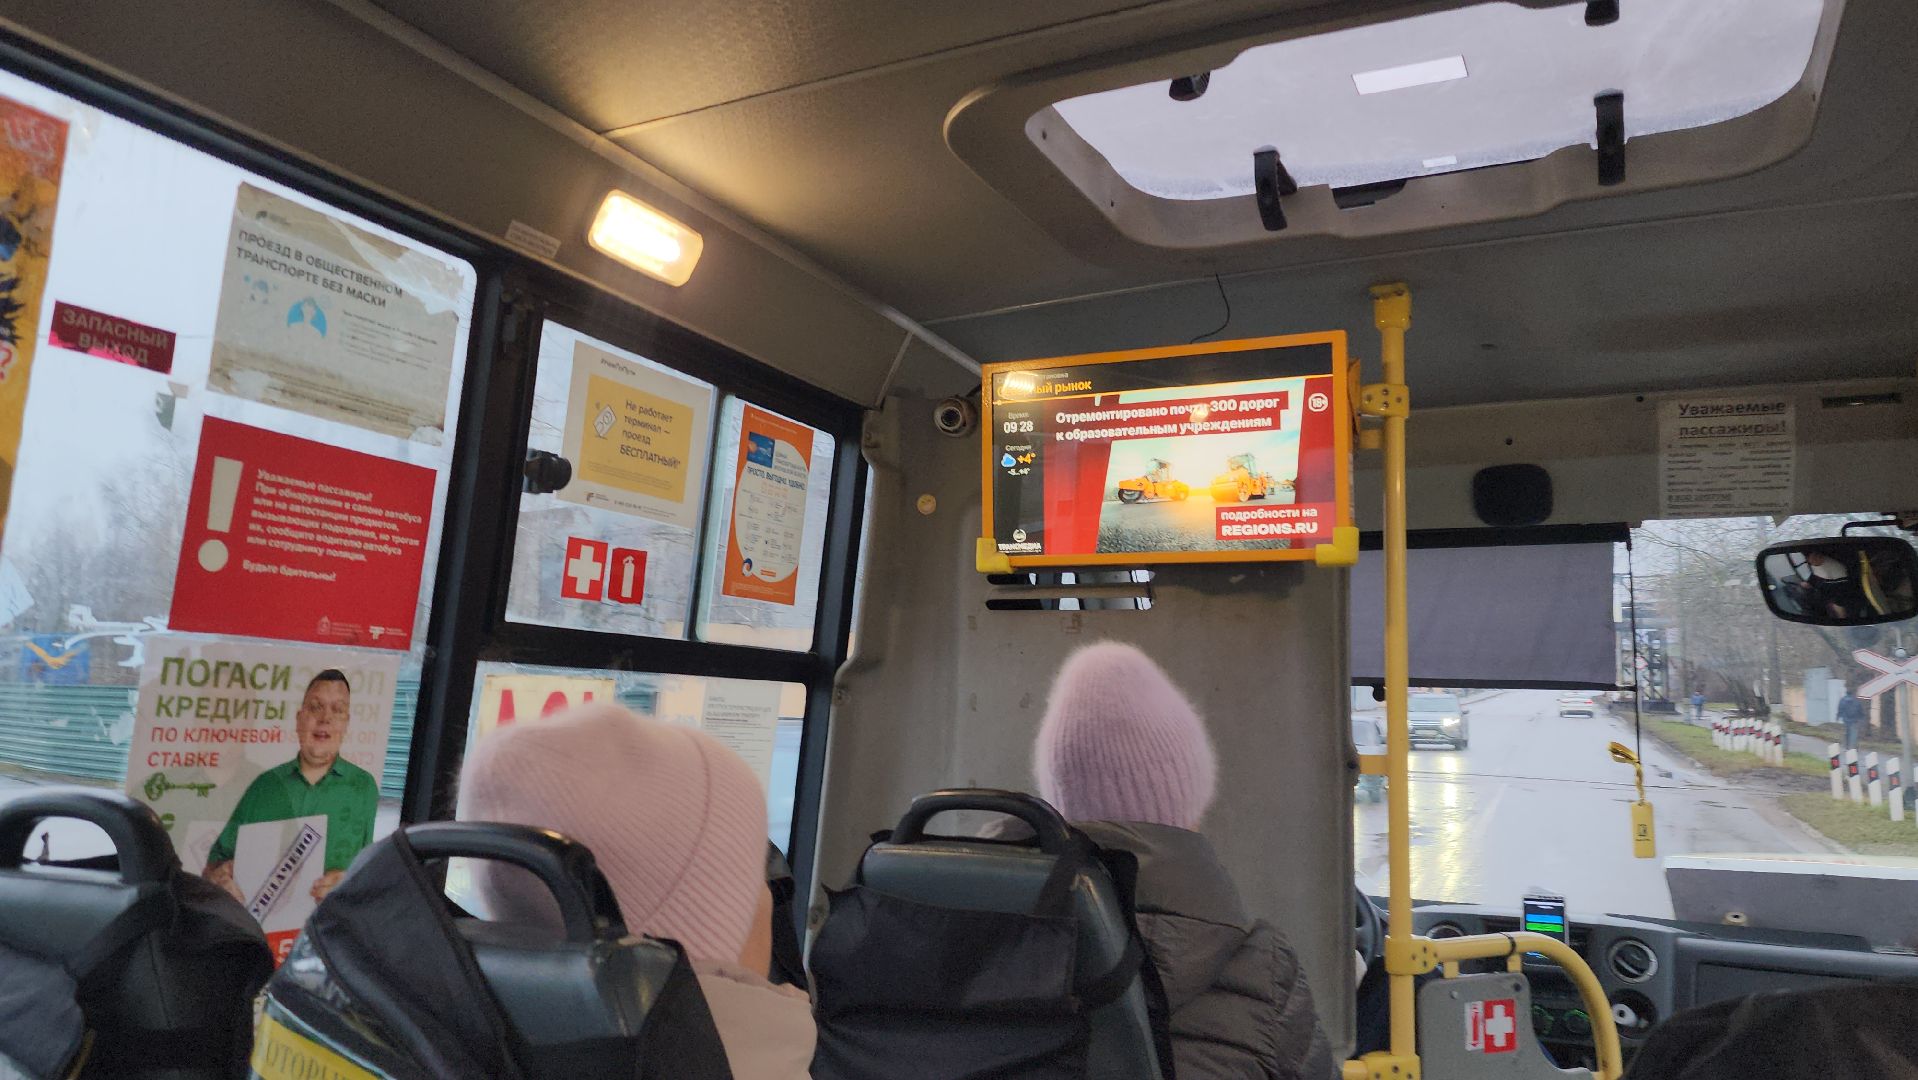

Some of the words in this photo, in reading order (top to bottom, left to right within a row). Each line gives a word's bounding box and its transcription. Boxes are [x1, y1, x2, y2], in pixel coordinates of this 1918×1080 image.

[238, 230, 291, 259] ПРОЕЗД
[294, 250, 303, 262] В
[305, 255, 403, 298] ОБЩЕСТВЕННОМ
[236, 247, 319, 285] ТРАНСПОРТЕ
[322, 278, 343, 294] БЕЗ
[346, 287, 386, 308] МАСКИ
[62, 308, 169, 349] ЗАПАСНЫЙ
[78, 332, 149, 366] ВЫХОД
[1054, 380, 1092, 396] рынок
[625, 399, 638, 411] Не
[638, 403, 673, 423] работает
[1055, 406, 1169, 425] Отремонтировано
[1169, 403, 1209, 416] почти
[1209, 398, 1238, 412] 300
[1238, 398, 1280, 412] дорог
[1678, 401, 1786, 417] Уважаемые
[624, 415, 662, 434] терминал
[1003, 421, 1018, 434] 09
[1019, 420, 1034, 433] 28
[1055, 431, 1065, 441] к
[1065, 423, 1178, 442] образовательным
[1179, 416, 1273, 435] учреждениям
[1679, 420, 1786, 436] пассажиры!
[622, 429, 651, 446] проезд
[257, 468, 316, 490] Уважаемые
[317, 483, 373, 502] пассажиры!
[255, 481, 277, 495] При
[384, 510, 422, 525] автобуса
[1220, 508, 1300, 522] подробности
[1301, 508, 1318, 518] на
[1221, 522, 1318, 537] REGIONS.RU
[242, 559, 279, 574] Будьте
[160, 656, 292, 692] ПОГАСИ
[155, 694, 286, 724] КРЕДИТЫ
[151, 726, 178, 743] ПО
[183, 725, 282, 744] КЛЮЧЕВОЙ
[146, 751, 220, 768] СТАВКЕ
